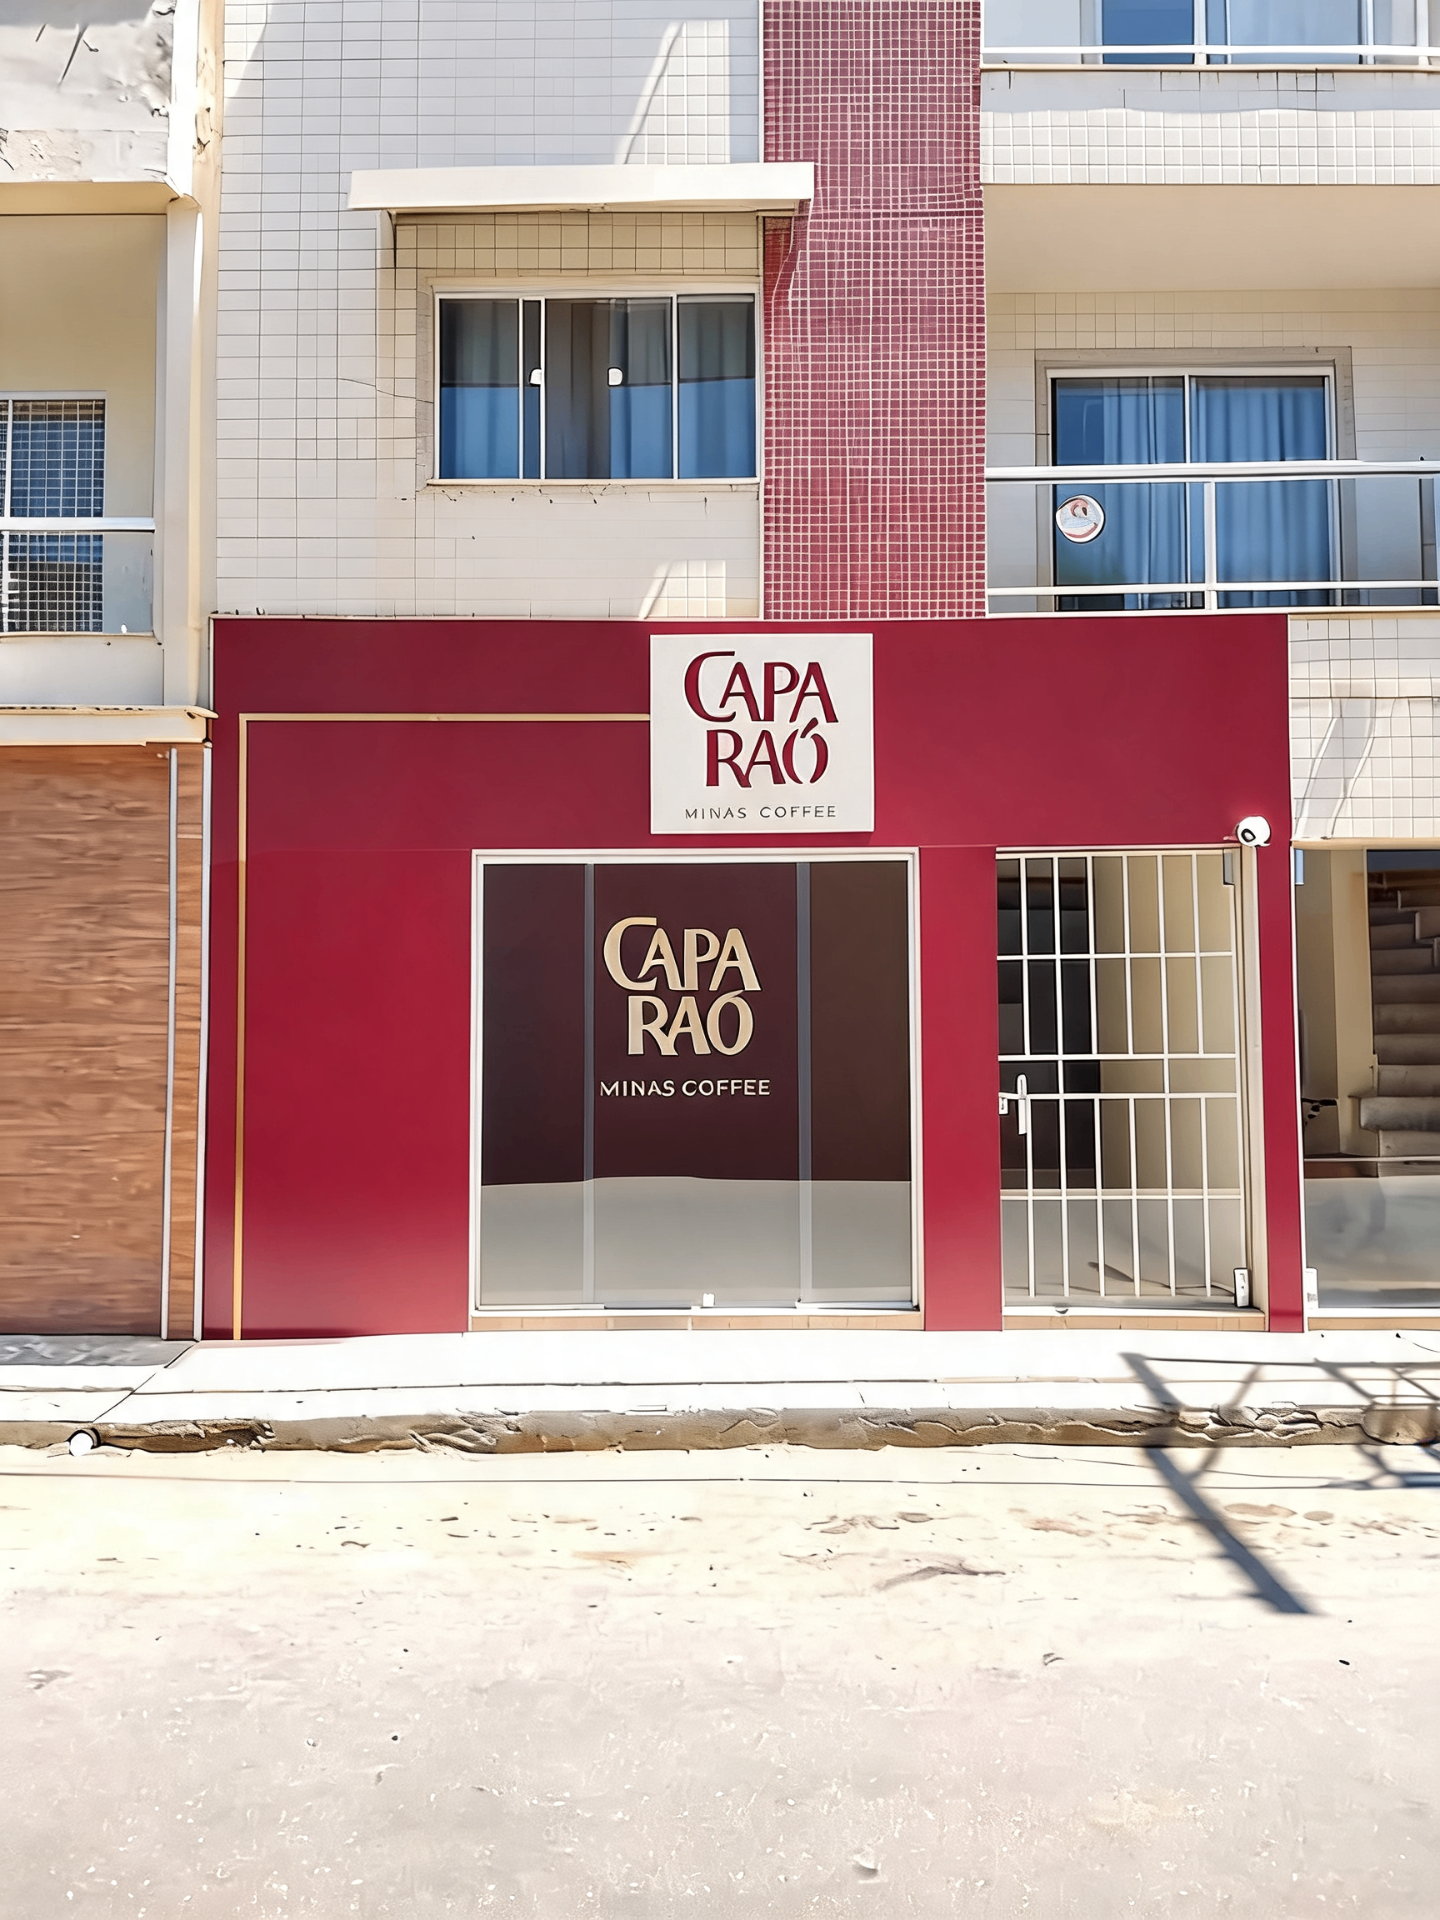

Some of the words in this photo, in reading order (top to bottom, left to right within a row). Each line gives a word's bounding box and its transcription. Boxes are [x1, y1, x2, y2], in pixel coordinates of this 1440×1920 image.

[684, 651, 839, 723] CAPA
[706, 717, 829, 788] RAÓ
[685, 807, 747, 820] MINAS
[759, 805, 837, 818] COFFEE
[603, 916, 762, 991] CAPA
[600, 1080, 675, 1097] MINAS
[681, 1079, 771, 1096] COFFEE
